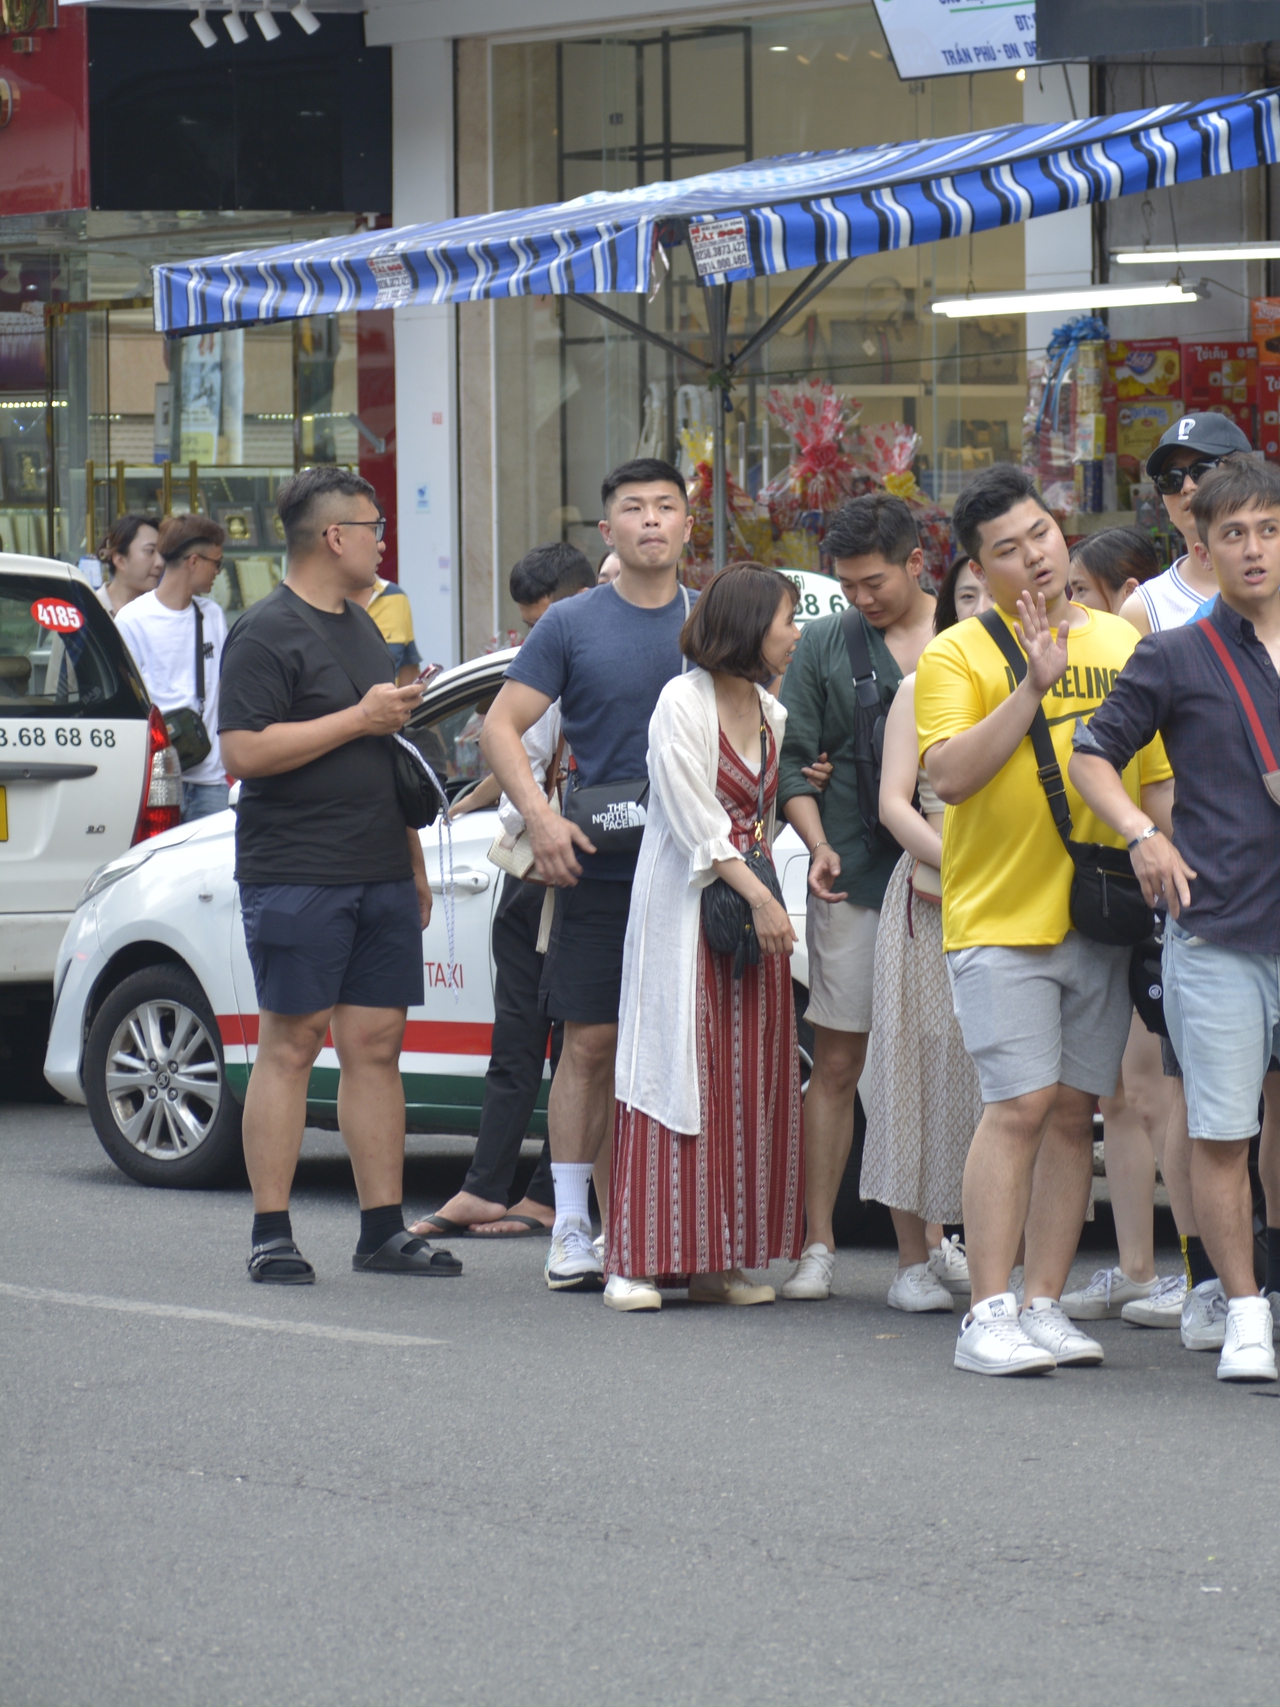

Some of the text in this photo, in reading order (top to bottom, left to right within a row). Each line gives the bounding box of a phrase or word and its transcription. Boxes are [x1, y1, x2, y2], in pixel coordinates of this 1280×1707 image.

[37, 603, 81, 629] 4185
[55, 727, 82, 747] 68
[90, 728, 116, 748] 68
[607, 801, 627, 812] THE
[592, 810, 628, 825] NORTH
[603, 818, 629, 831] FACE
[424, 962, 464, 989] TAXI
